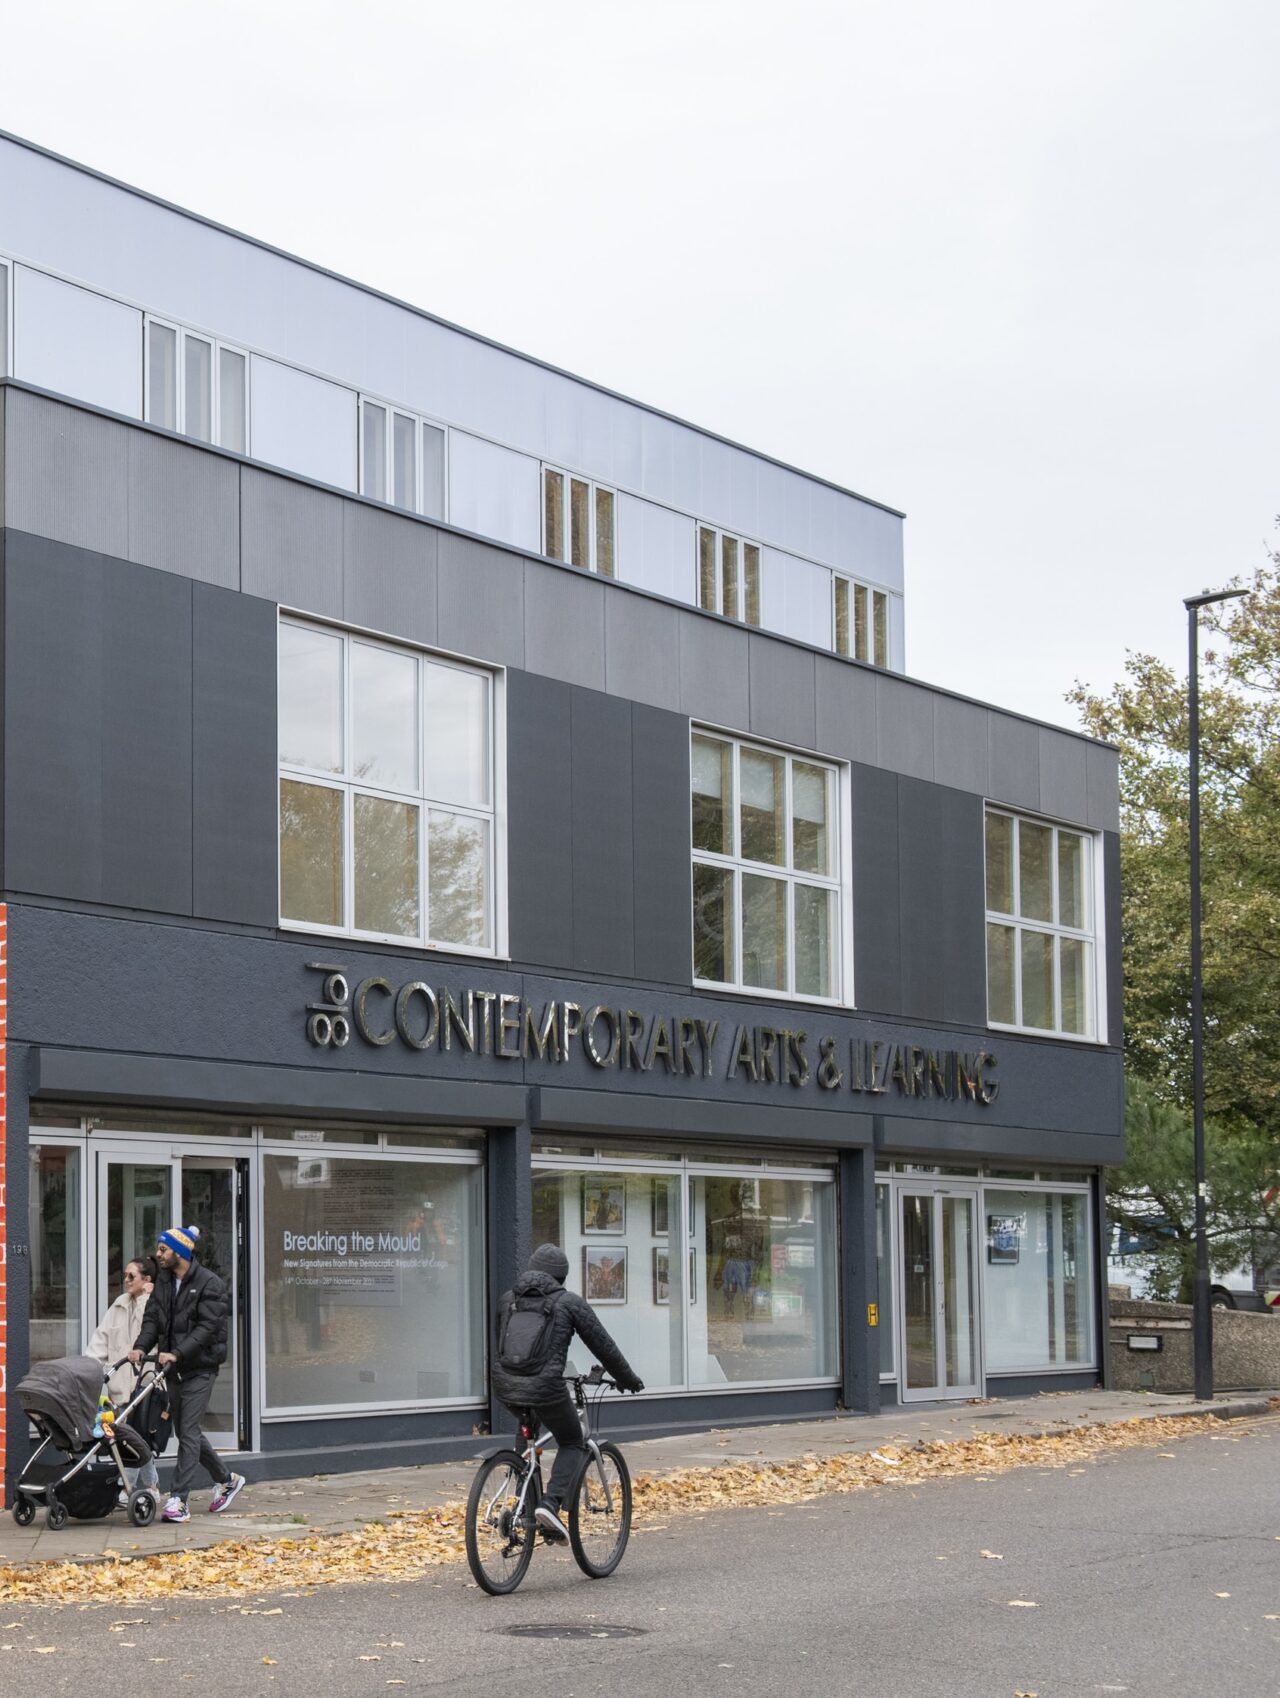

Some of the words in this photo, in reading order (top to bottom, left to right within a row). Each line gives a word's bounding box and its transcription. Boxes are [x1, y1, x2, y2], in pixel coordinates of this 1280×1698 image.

[353, 976, 719, 1078] CONTEMPORARY
[727, 1024, 810, 1087] ARTS
[818, 1036, 843, 1089] &
[850, 1037, 1000, 1105] LEARNING
[283, 1230, 347, 1256] Breaking
[351, 1231, 375, 1252] the
[378, 1232, 421, 1252] Mould
[283, 1258, 298, 1268] New
[299, 1258, 332, 1270] Signatures
[332, 1258, 347, 1268] from
[348, 1258, 359, 1268] the
